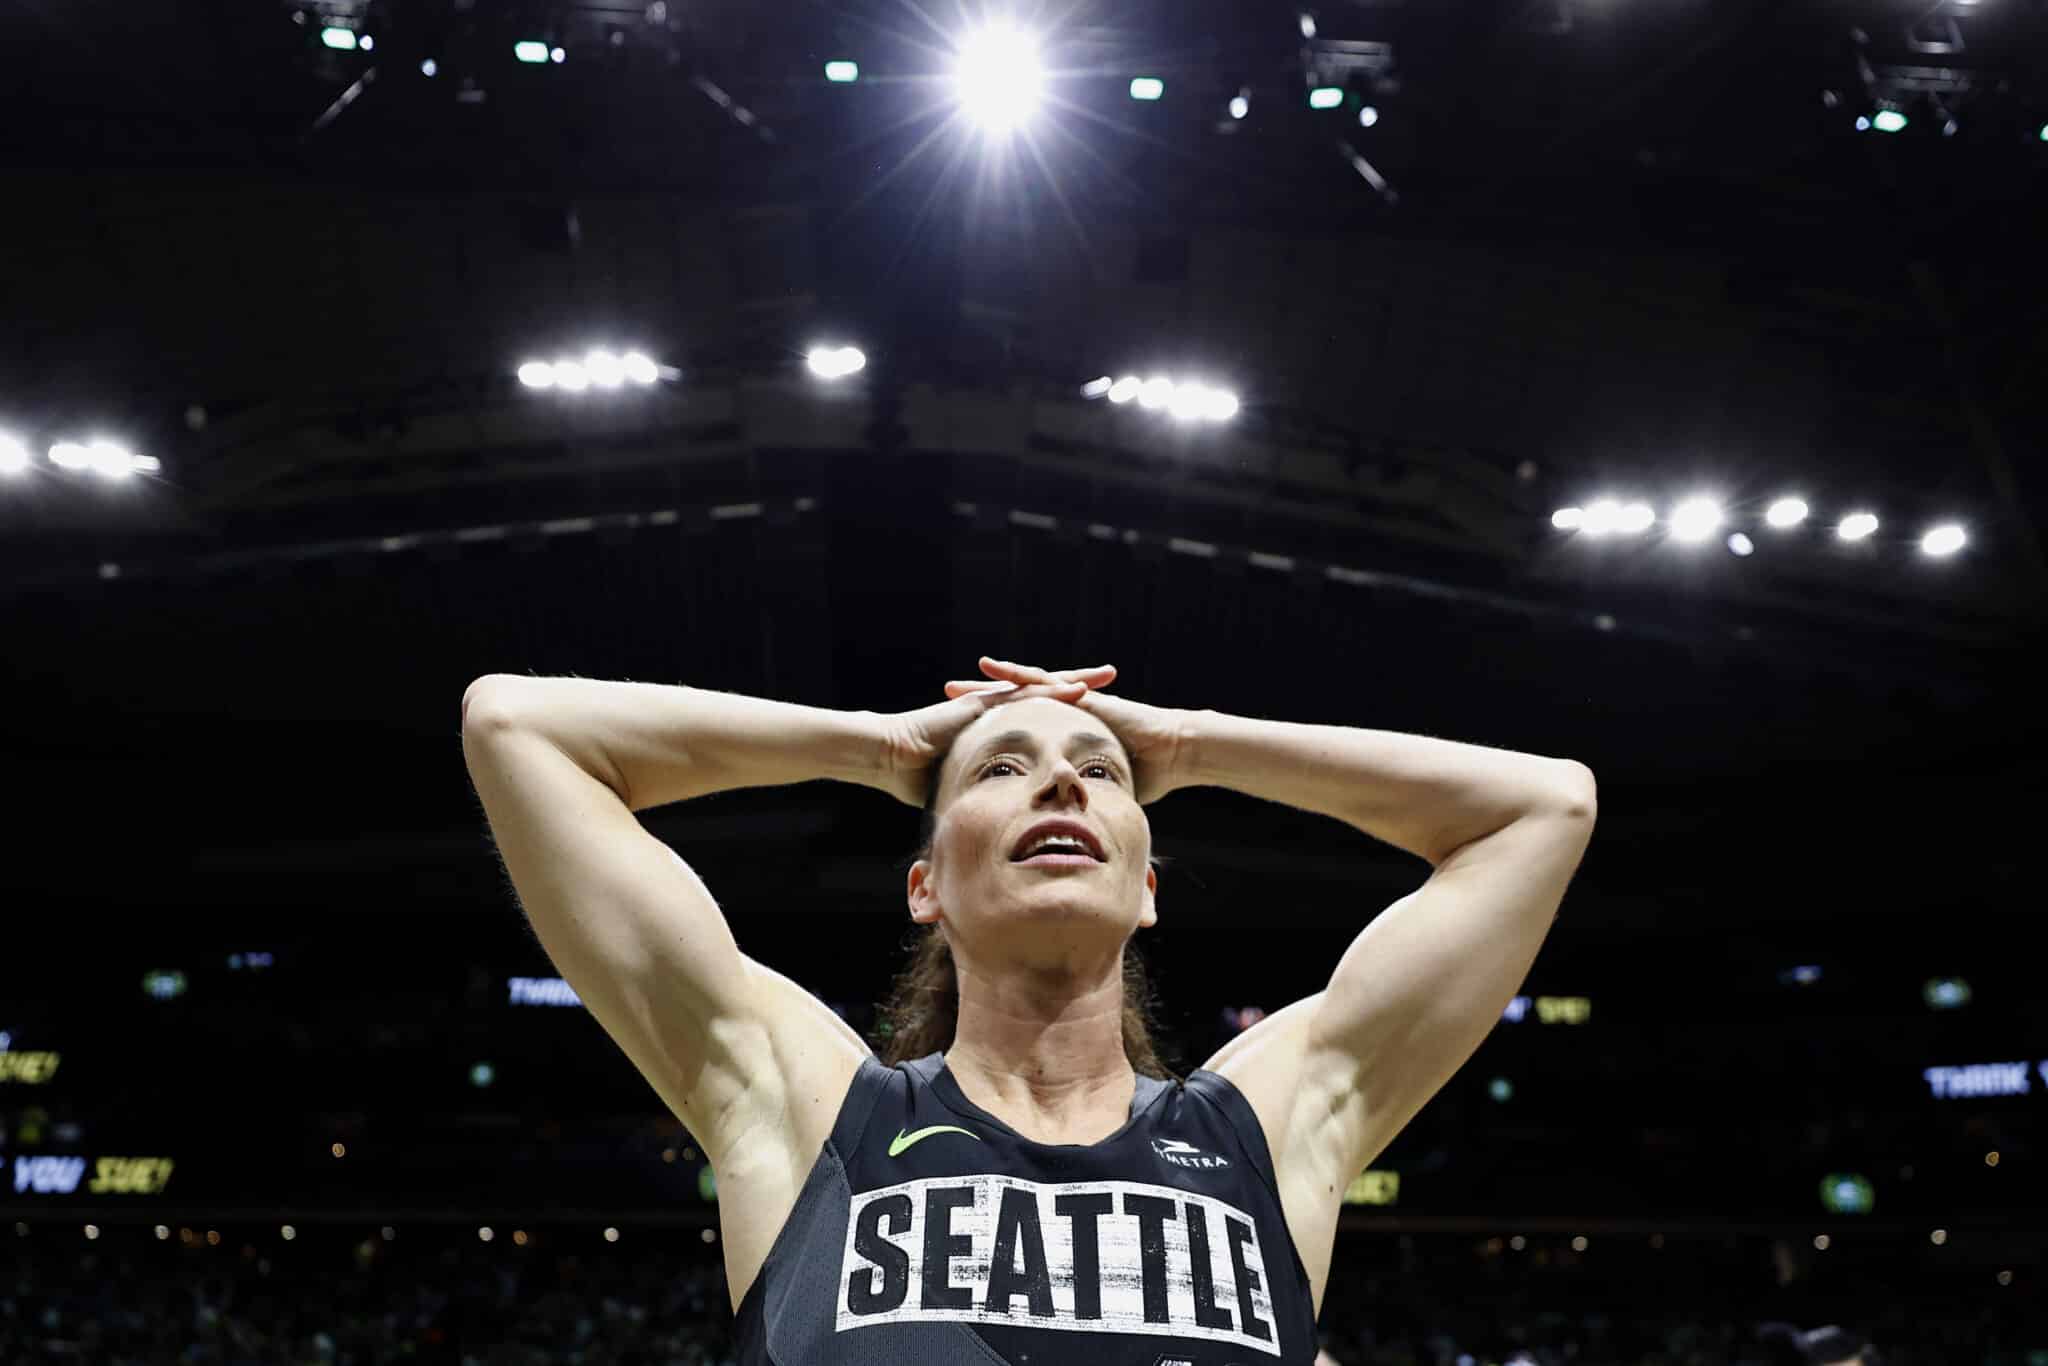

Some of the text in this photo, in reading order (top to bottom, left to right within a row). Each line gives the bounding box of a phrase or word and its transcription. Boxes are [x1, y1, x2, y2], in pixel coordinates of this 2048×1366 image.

[1924, 1061, 2030, 1099] THANK
[14, 1156, 174, 1194] YOU SUE!
[848, 1186, 1273, 1343] SEATTLE
